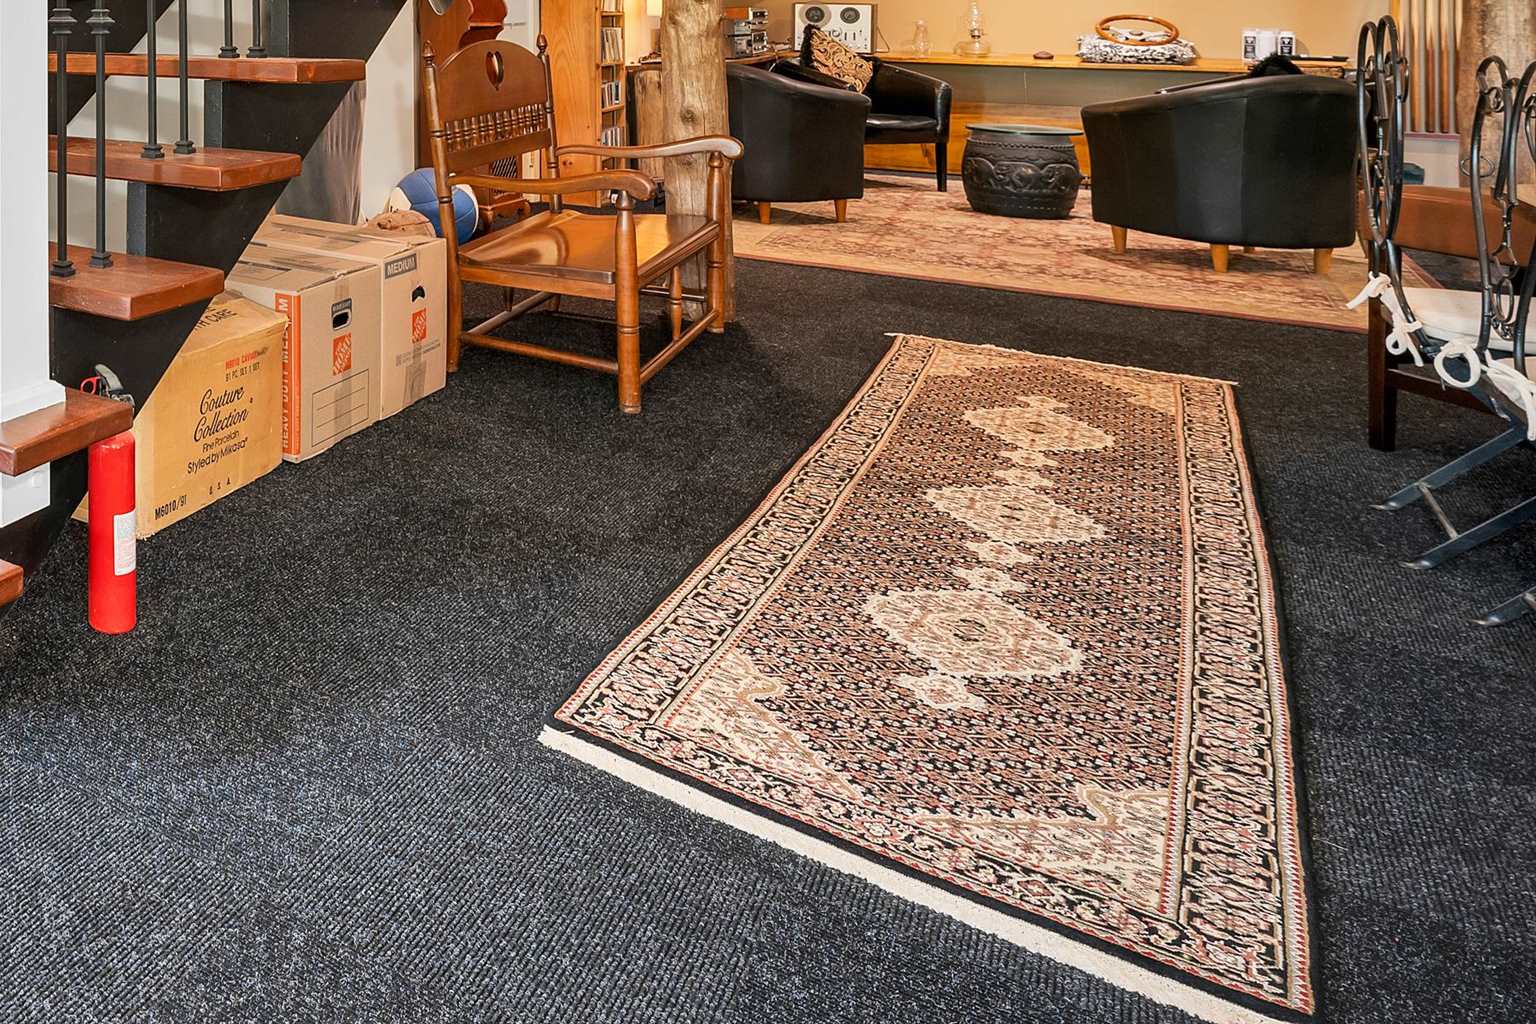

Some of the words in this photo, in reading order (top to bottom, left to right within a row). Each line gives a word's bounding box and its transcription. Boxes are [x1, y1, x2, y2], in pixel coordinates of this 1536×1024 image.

[387, 256, 416, 276] MEDIUM
[199, 386, 245, 415] Couture
[193, 408, 249, 442] Collection
[187, 456, 211, 474] Styled
[210, 453, 220, 464] by
